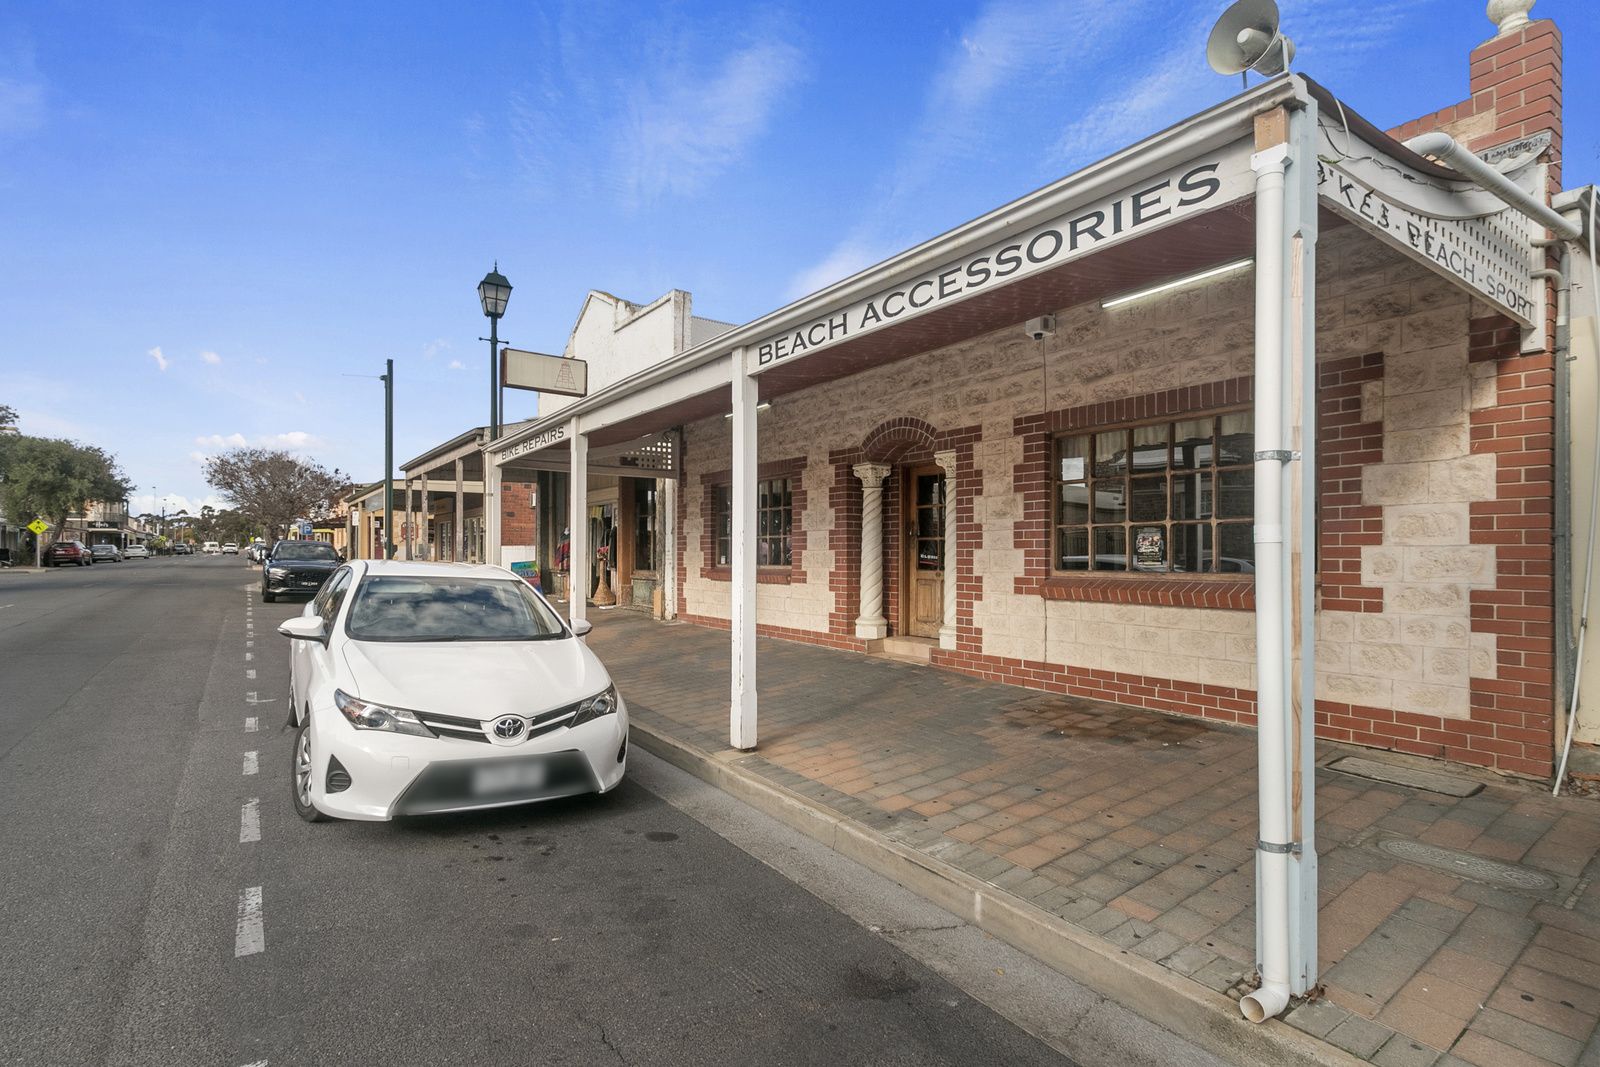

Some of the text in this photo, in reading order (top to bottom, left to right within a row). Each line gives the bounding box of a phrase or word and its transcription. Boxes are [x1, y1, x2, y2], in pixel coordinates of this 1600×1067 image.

[758, 162, 1221, 366] BEACH ACCESSORIES
[1486, 274, 1535, 320] SPORT
[502, 426, 565, 460] BIKE REPAIRS
